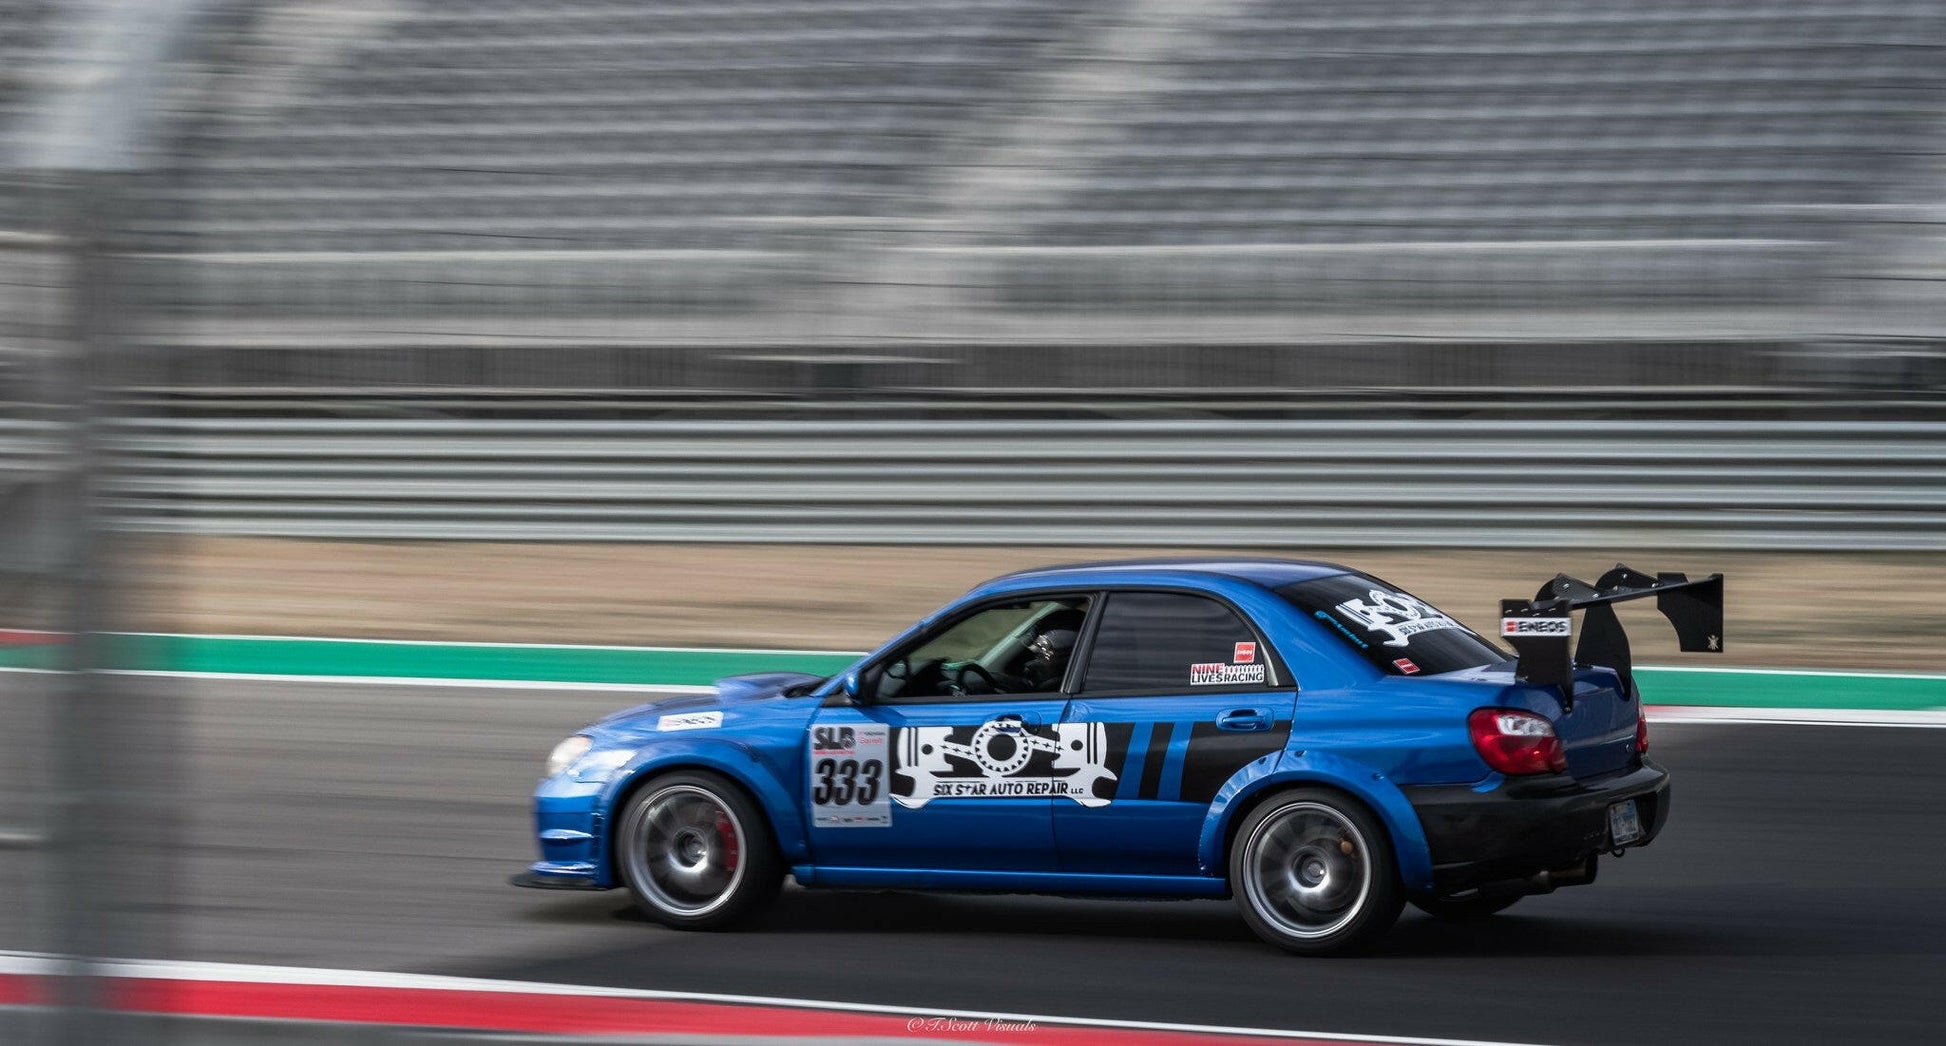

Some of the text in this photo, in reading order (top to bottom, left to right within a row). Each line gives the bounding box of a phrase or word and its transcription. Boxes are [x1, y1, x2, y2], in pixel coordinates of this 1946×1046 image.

[1518, 621, 1567, 632] ENEOS
[1192, 664, 1224, 674] NINE
[813, 758, 883, 806] 333
[933, 784, 951, 796] SIX
[989, 783, 1023, 795] AUTO
[1026, 782, 1069, 795] REPAIR
